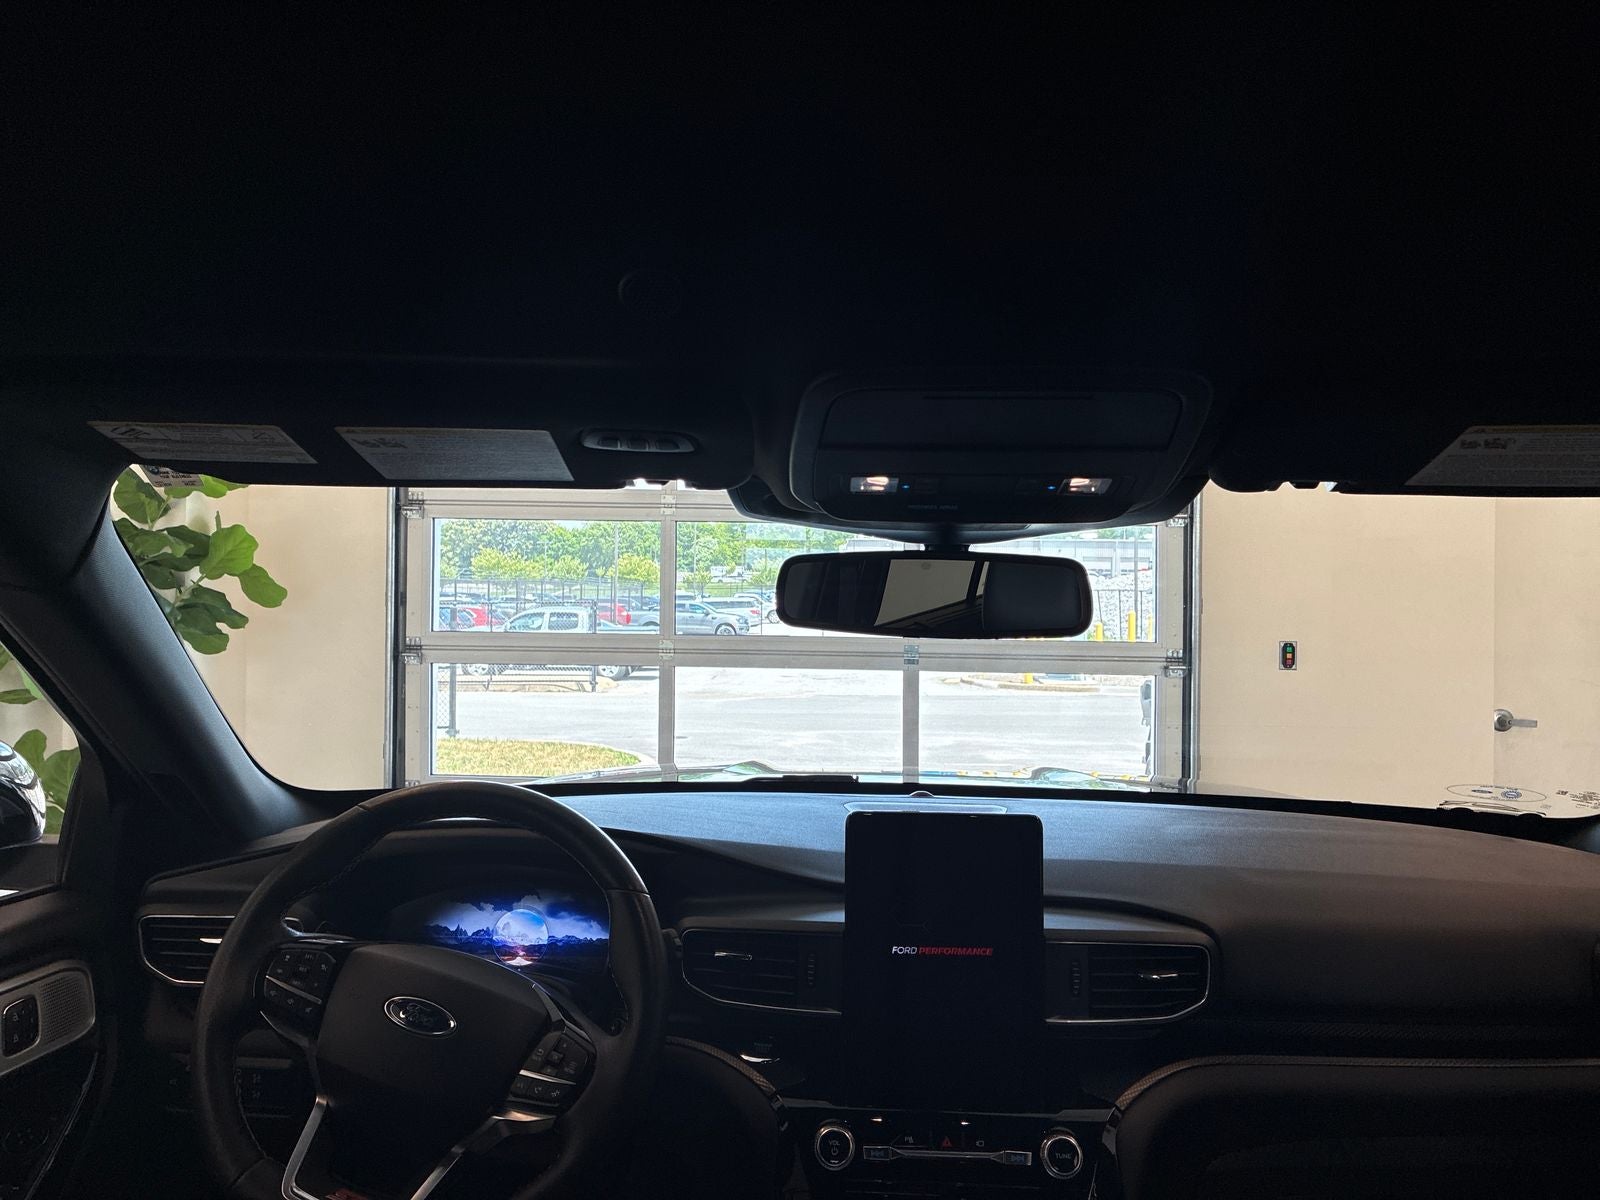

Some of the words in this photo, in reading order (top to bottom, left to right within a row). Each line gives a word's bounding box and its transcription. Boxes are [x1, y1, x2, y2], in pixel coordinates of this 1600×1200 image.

[891, 945, 918, 955] FORD
[918, 946, 994, 957] PERFORMANCE
[1055, 1152, 1073, 1160] TUNE
